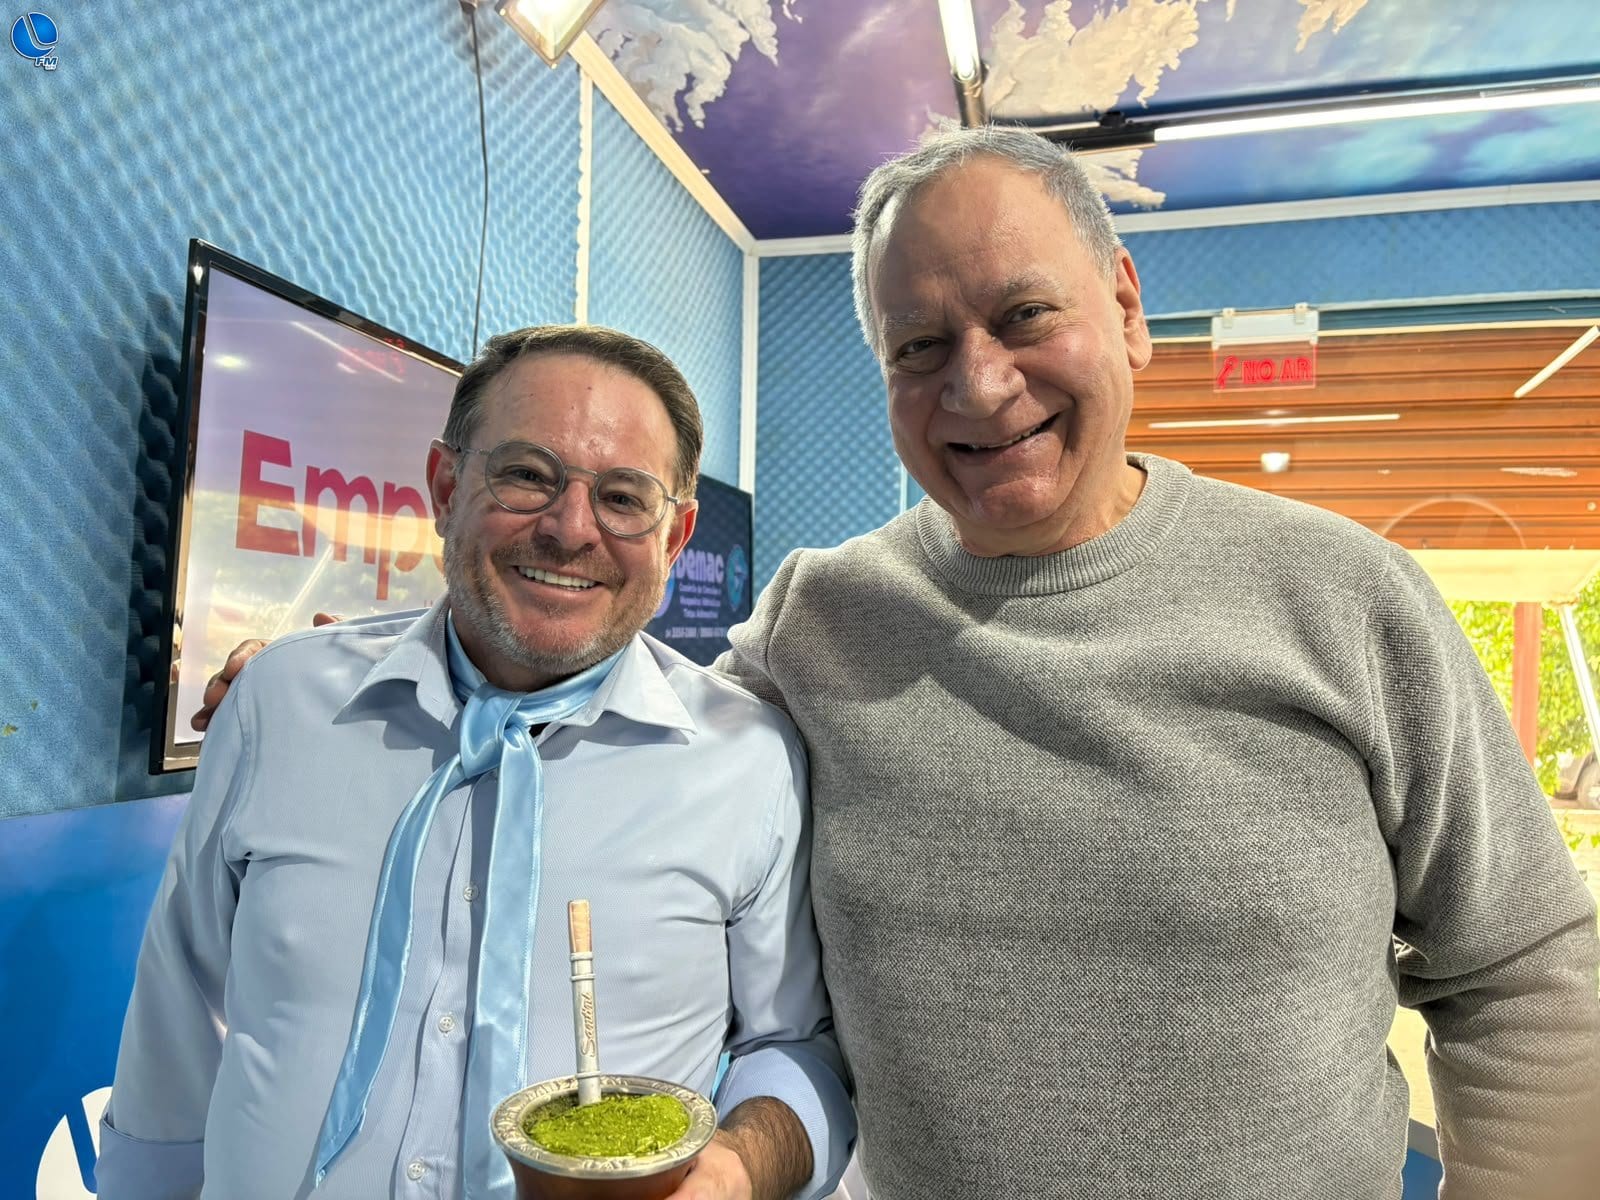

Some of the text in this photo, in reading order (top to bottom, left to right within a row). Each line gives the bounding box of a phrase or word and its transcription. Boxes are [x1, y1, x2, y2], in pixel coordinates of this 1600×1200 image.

[1242, 356, 1312, 384] NO AR
[236, 430, 446, 600] Emp
